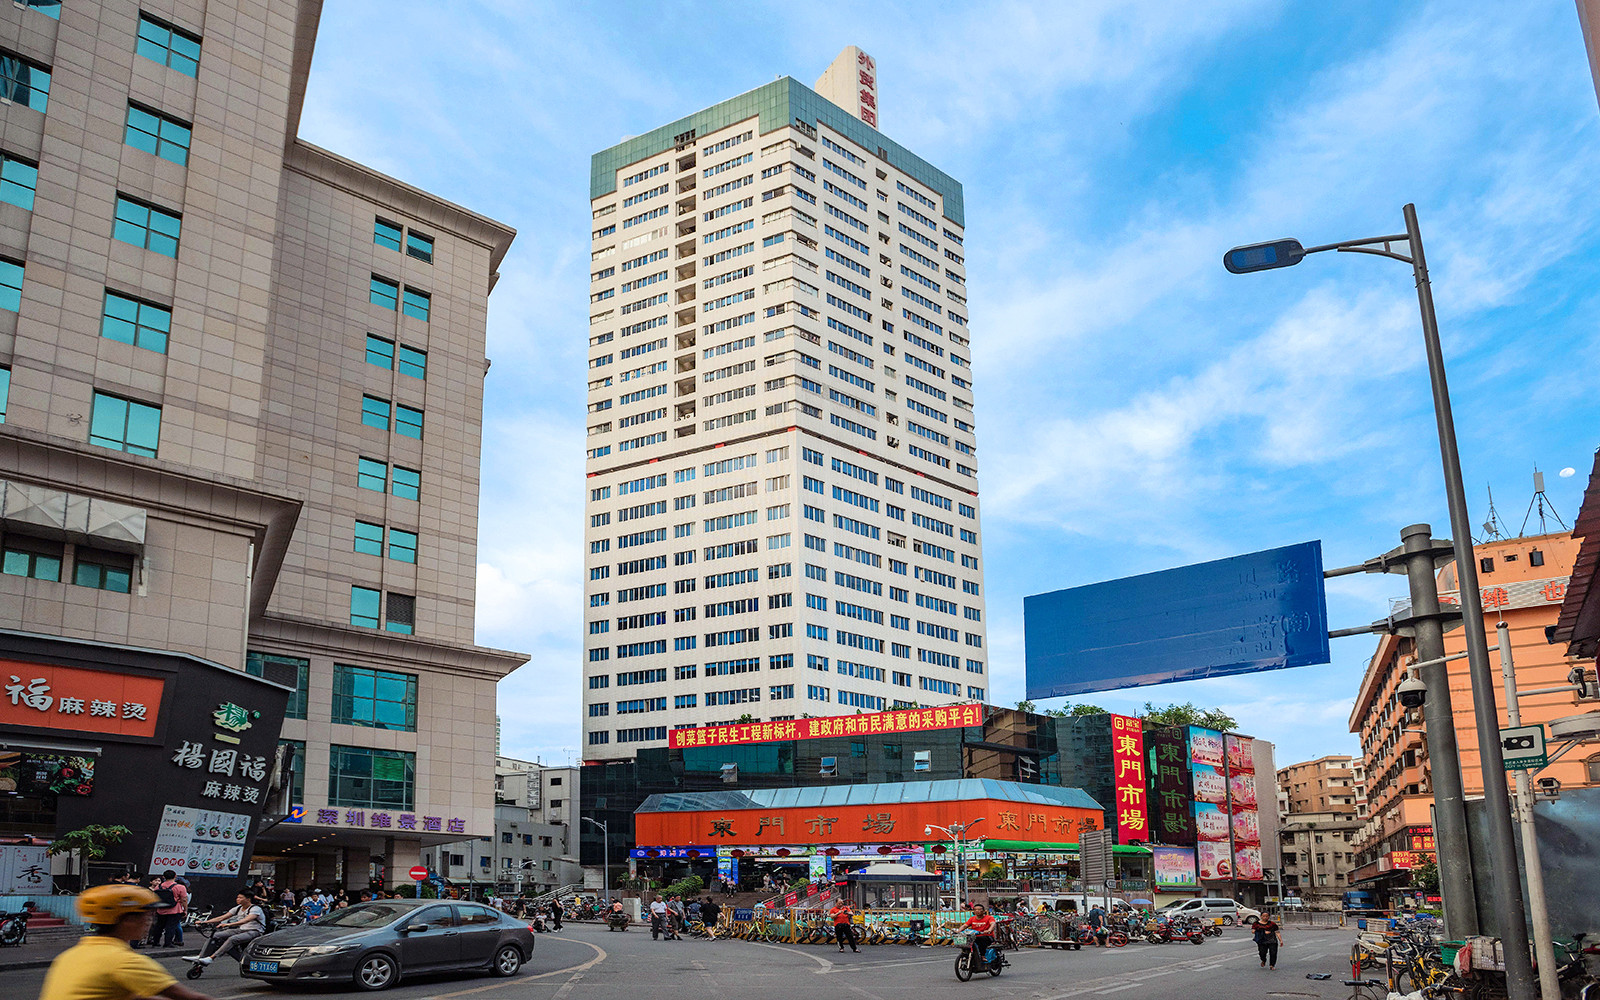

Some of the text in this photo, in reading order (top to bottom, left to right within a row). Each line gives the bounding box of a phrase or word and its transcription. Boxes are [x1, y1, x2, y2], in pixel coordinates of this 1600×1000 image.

[172, 740, 266, 782] 楊國福
[201, 780, 260, 804] 麻辣烫
[1116, 735, 1146, 830] 東門市場
[317, 808, 466, 833] 深圳维景酒店
[708, 813, 897, 838] 東門市場
[997, 810, 1098, 834] 東門市場
